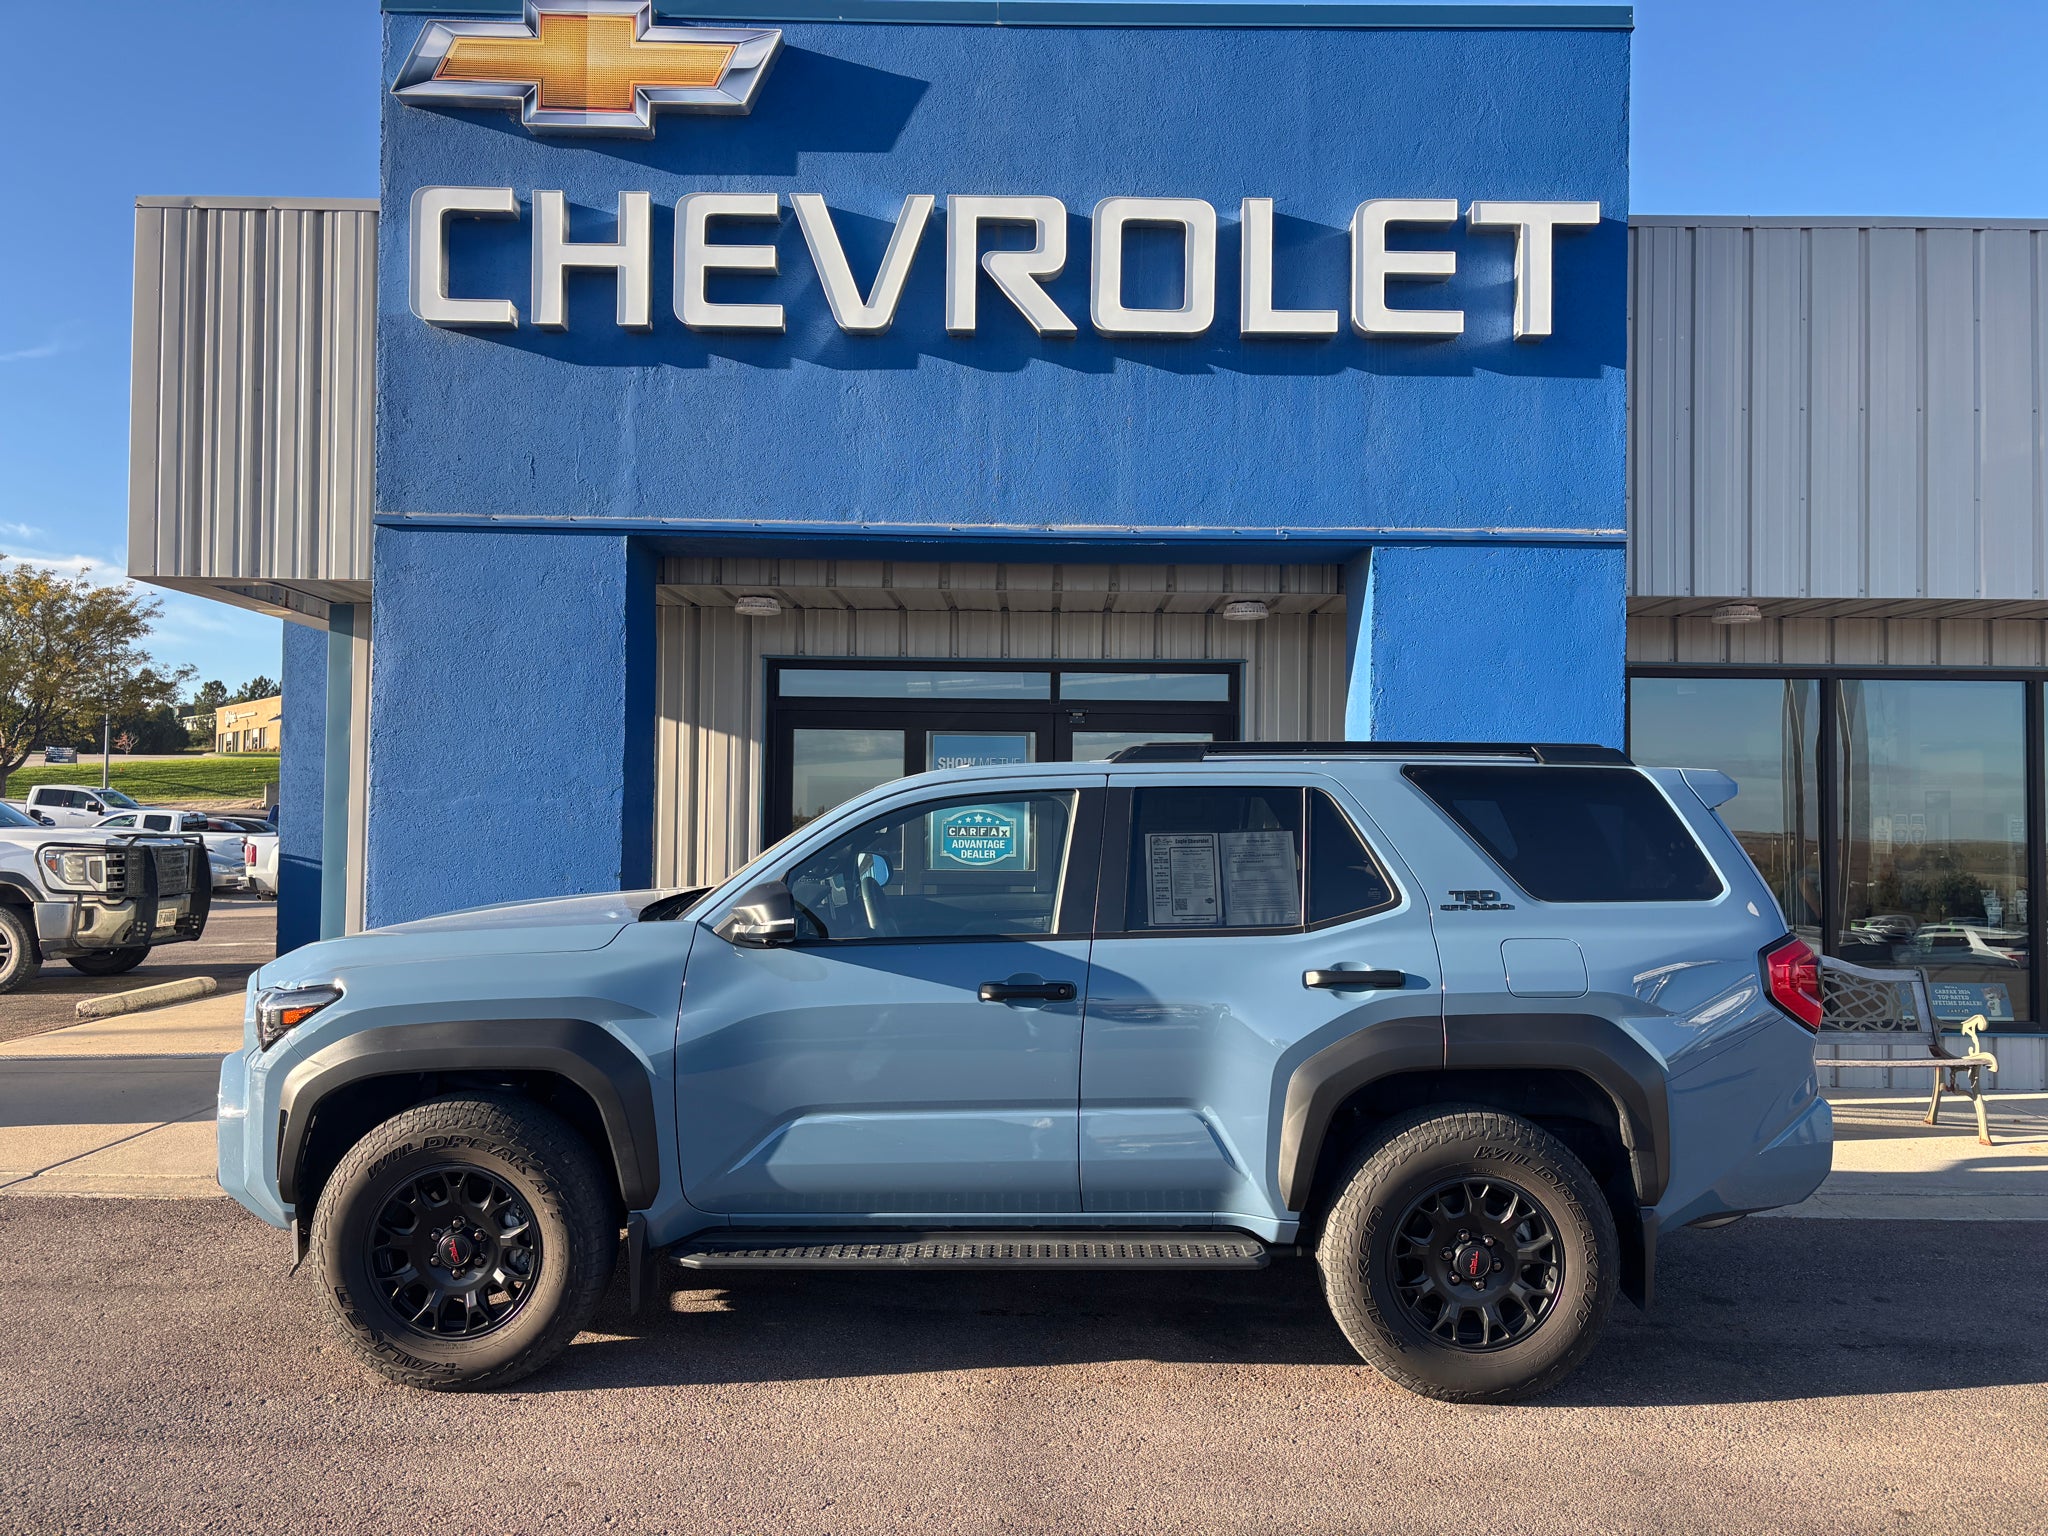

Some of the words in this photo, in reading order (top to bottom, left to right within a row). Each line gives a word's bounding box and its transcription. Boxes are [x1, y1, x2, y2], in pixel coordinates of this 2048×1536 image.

[409, 186, 1601, 341] CHEVROLET
[937, 757, 976, 769] SHOW
[980, 757, 997, 766] ME
[947, 826, 1010, 838] CARFAX
[952, 839, 1005, 849] ADVANTAGE
[961, 849, 996, 859] DEALER
[1448, 889, 1501, 905] TRD
[367, 1134, 532, 1181] WILDPEAK
[1474, 1145, 1599, 1269] WILDPEAK
[449, 1238, 460, 1264] TRD
[1469, 1250, 1480, 1275] TRD
